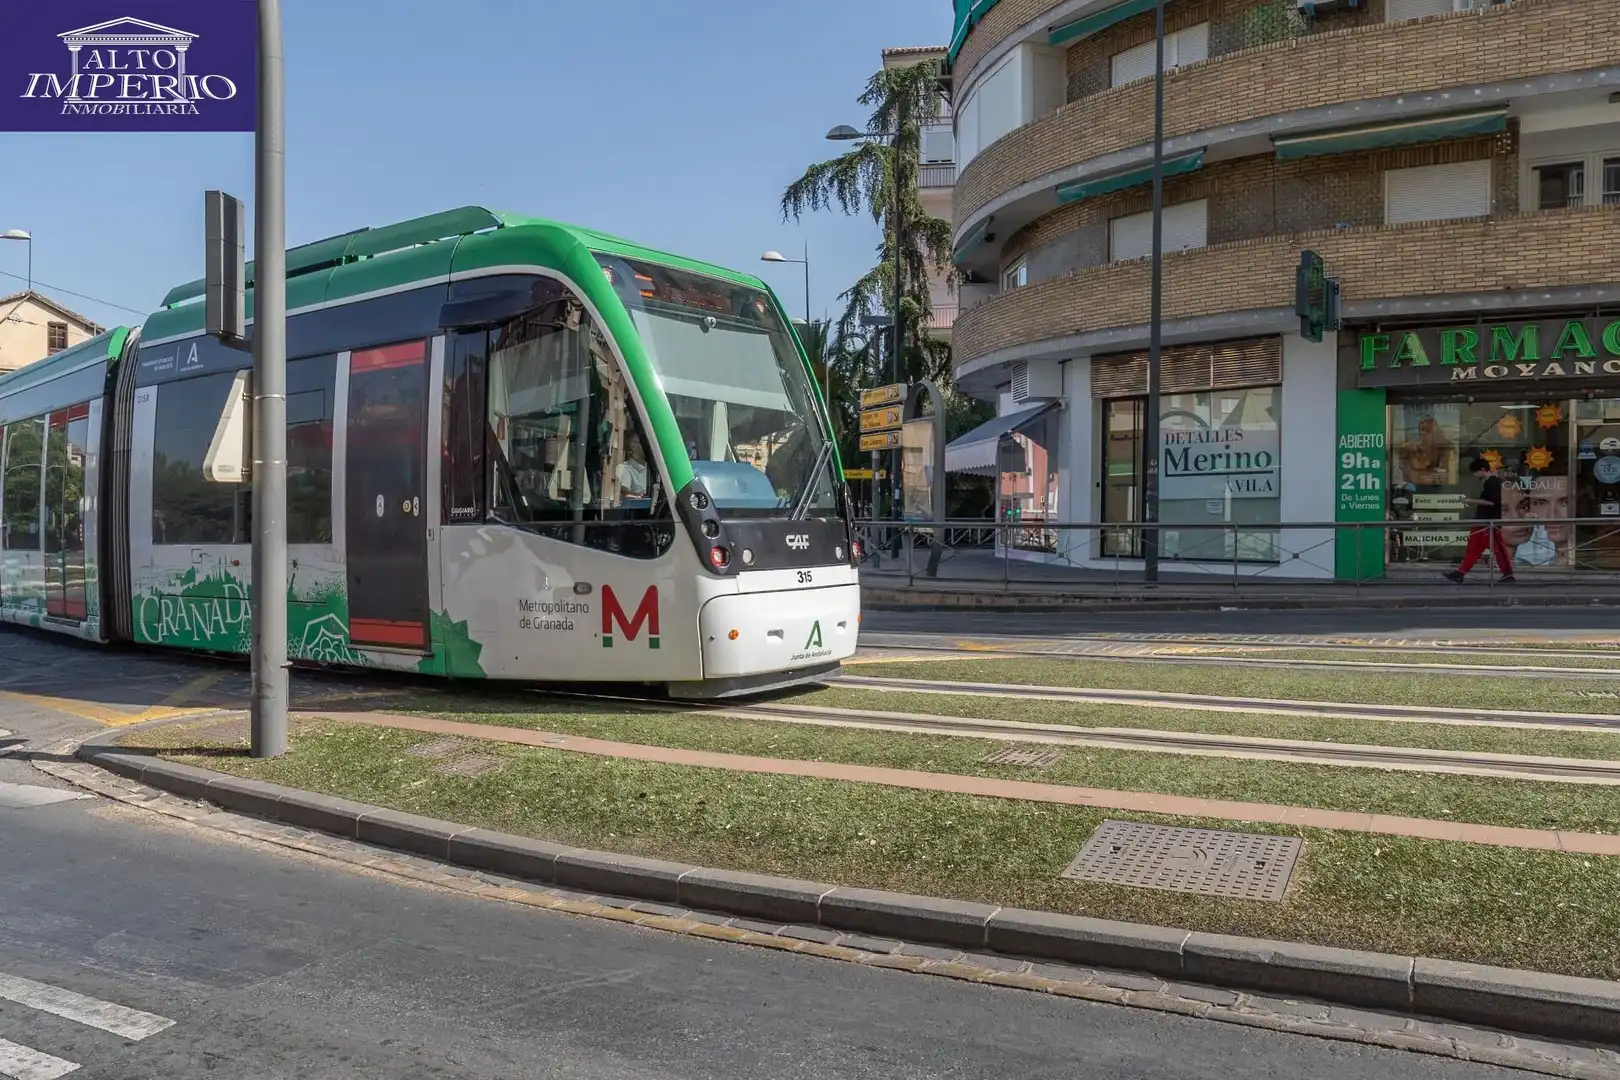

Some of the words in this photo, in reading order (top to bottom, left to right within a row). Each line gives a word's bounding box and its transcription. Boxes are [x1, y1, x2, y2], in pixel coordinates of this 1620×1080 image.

[1165, 429, 1243, 445] DETALLES
[1339, 434, 1384, 448] ABIERTO
[1165, 444, 1272, 471] Merino
[1341, 452, 1369, 469] 9h
[1371, 460, 1381, 469] a
[1341, 473, 1380, 490] 21h
[1348, 502, 1380, 510] Viernes
[785, 534, 810, 550] CAF
[797, 570, 812, 584] 315
[140, 584, 252, 643] GRANADA
[519, 599, 590, 615] Metropolitano
[520, 616, 531, 629] de
[533, 616, 574, 631] Granada
[790, 653, 805, 661] Junta
